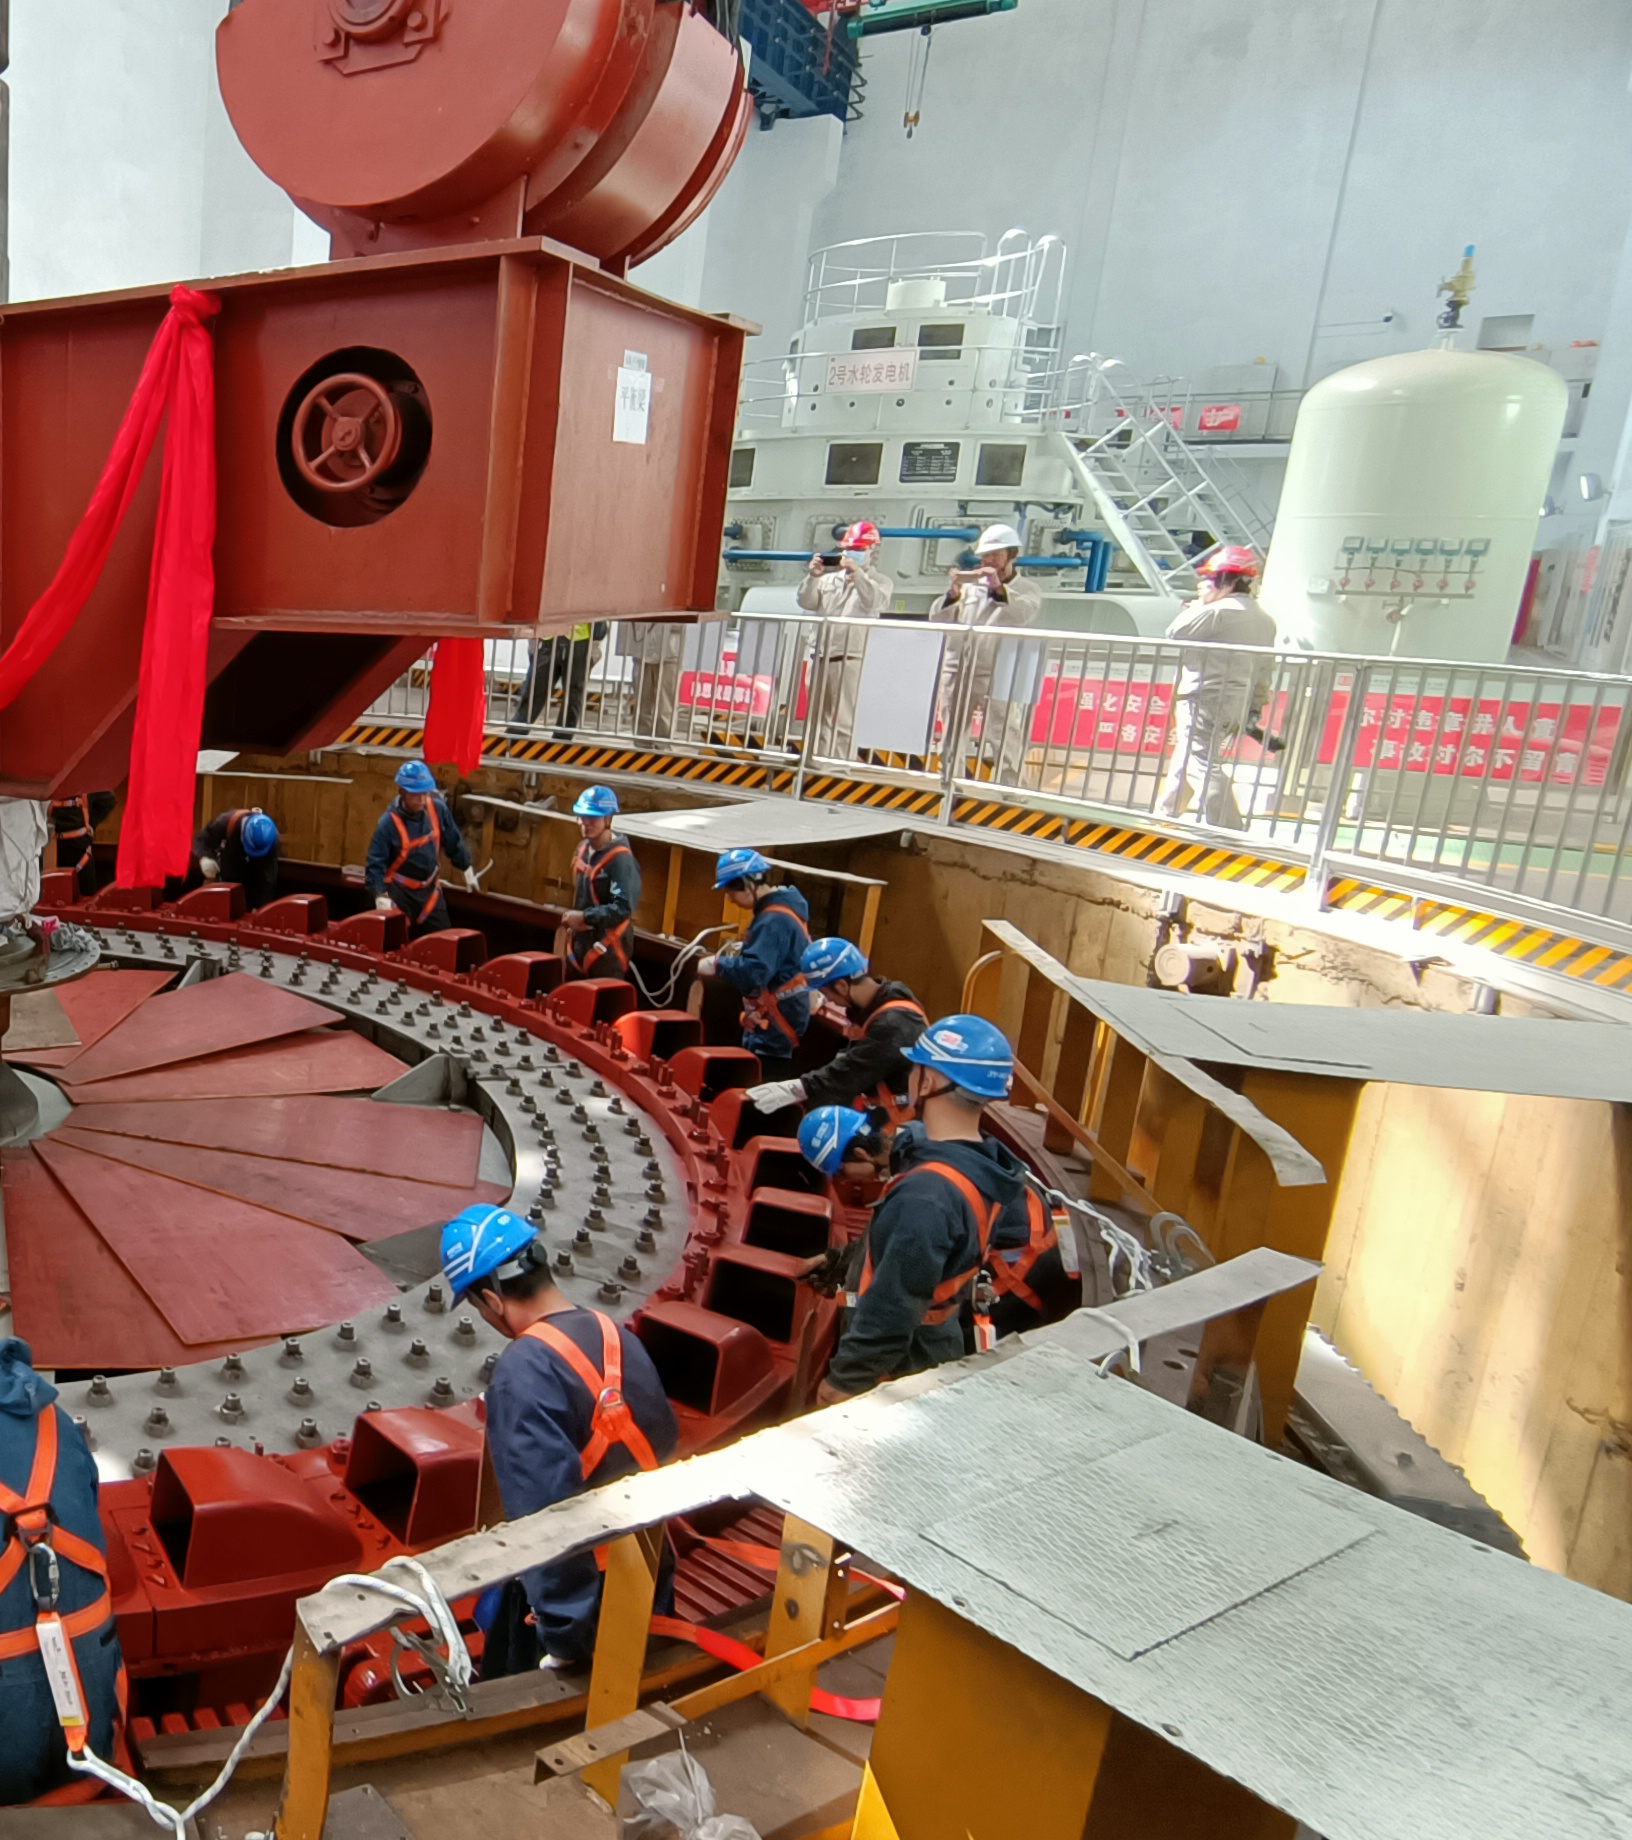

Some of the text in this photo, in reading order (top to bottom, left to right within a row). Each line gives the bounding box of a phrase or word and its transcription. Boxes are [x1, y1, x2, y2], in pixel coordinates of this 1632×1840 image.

[828, 361, 910, 386] 2号水轮发电机
